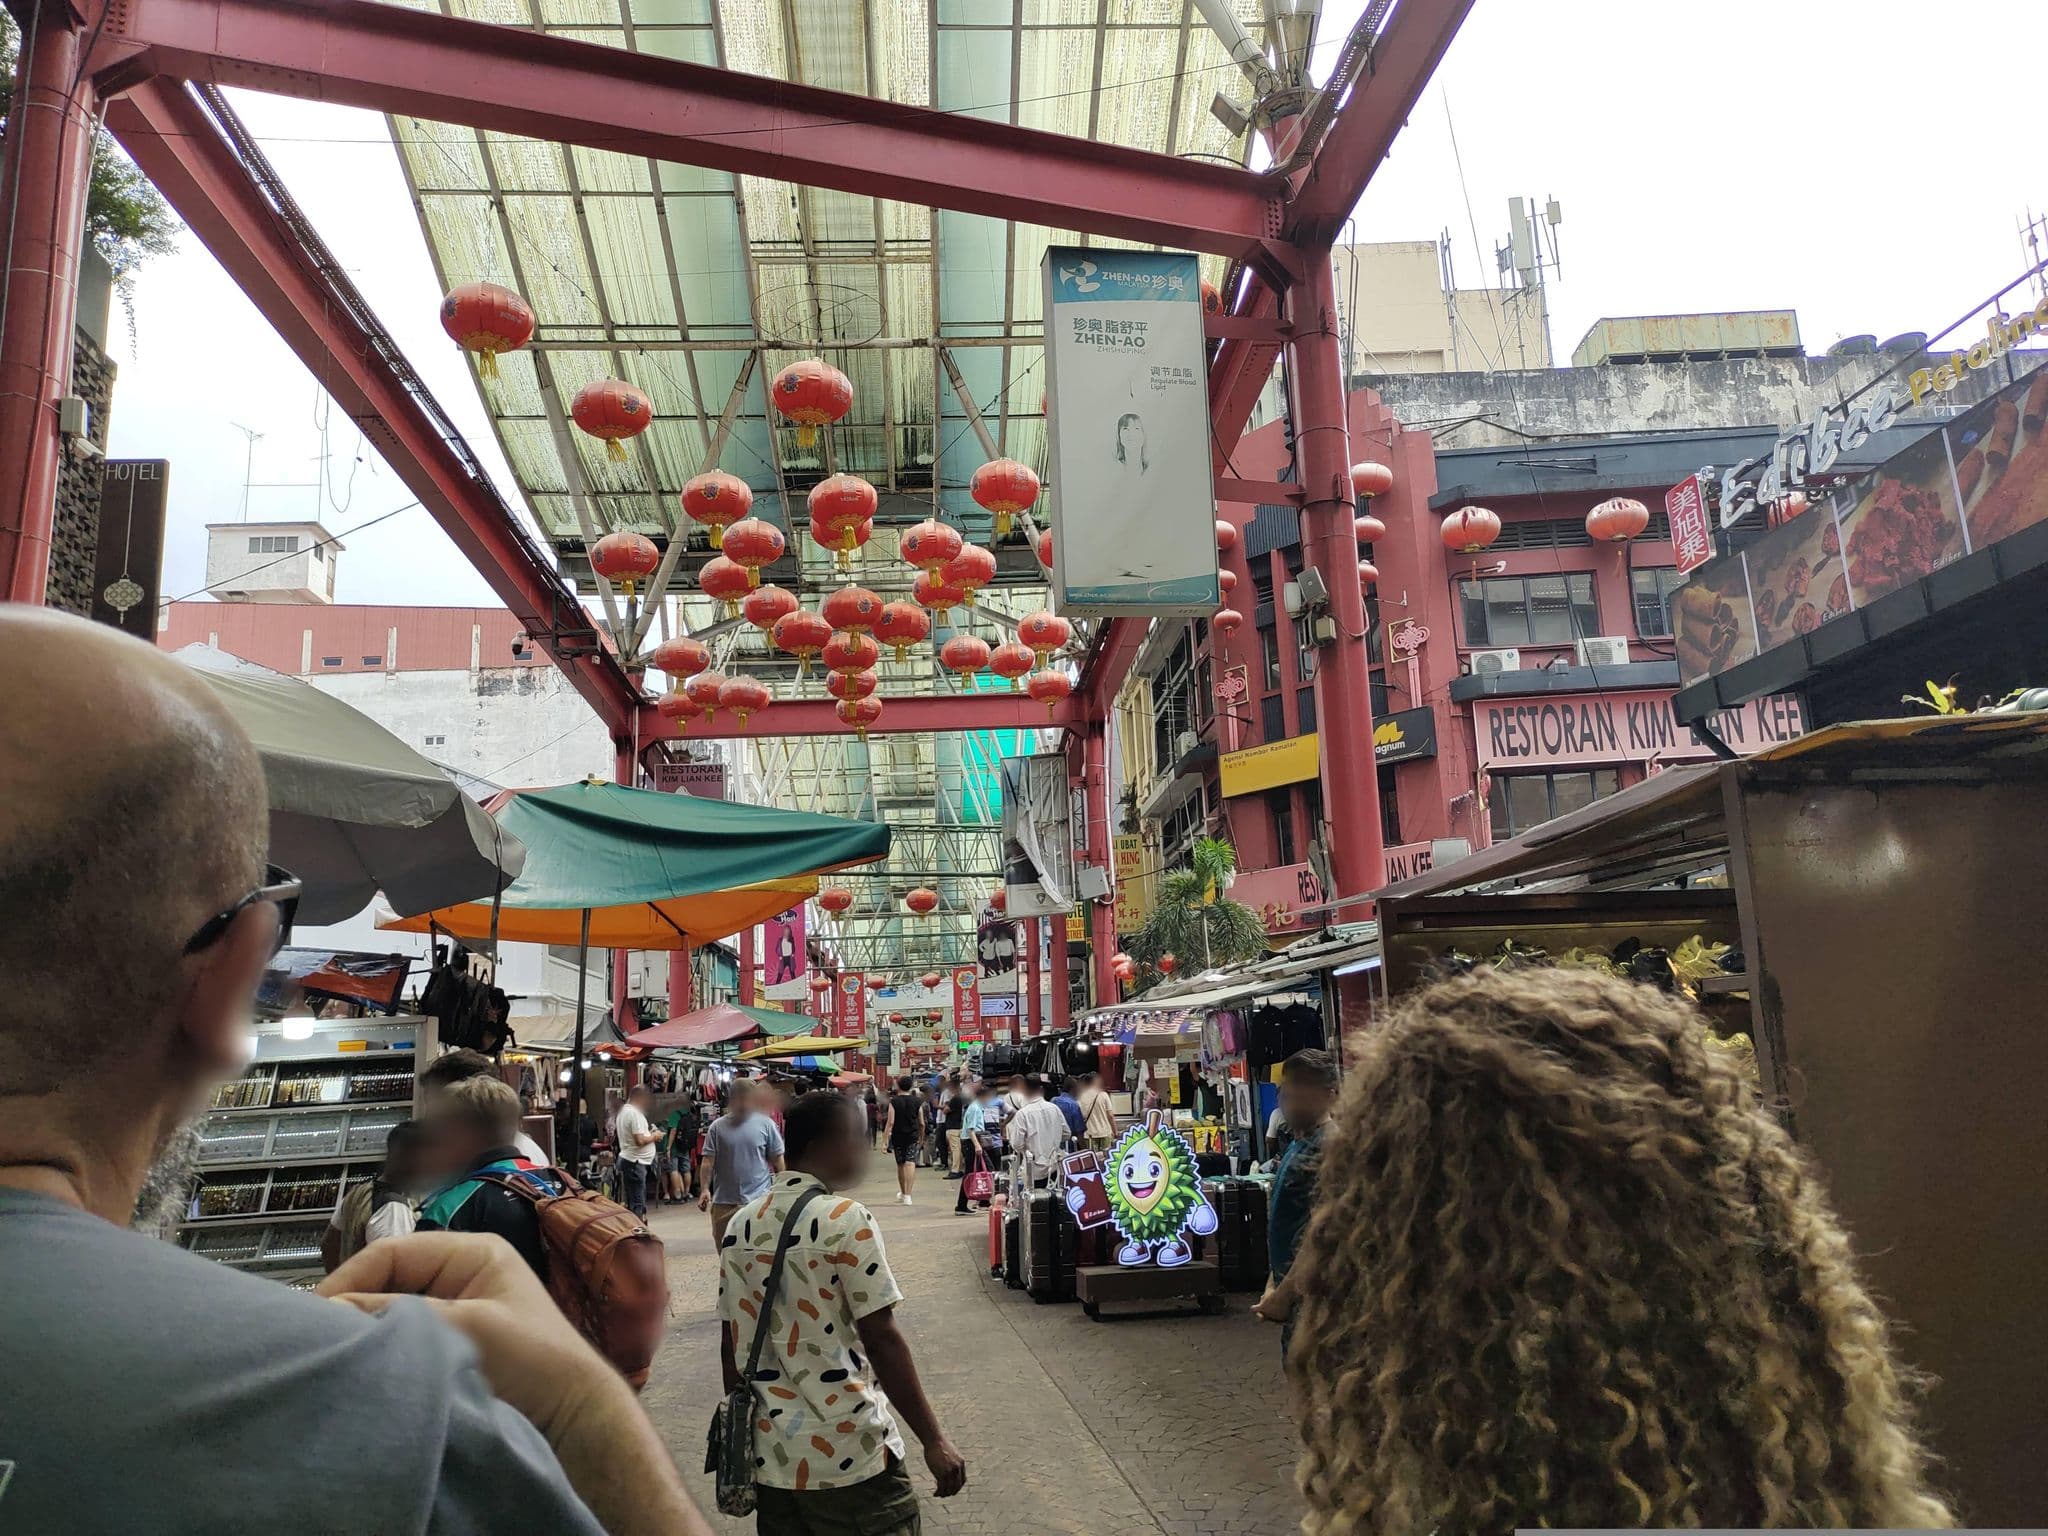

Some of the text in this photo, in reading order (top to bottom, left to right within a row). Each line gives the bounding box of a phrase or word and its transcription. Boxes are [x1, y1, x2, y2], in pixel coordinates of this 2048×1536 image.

[1102, 271, 1151, 283] ZHEN-AO
[1074, 332, 1146, 348] ZHEN-AO
[1150, 377, 1177, 386] Regulate
[1719, 385, 1897, 528] Edibee
[105, 463, 161, 480] HOTEL
[1489, 702, 1616, 758] RESTORAN
[1626, 700, 1676, 750] KIM
[1754, 694, 1801, 743] KEE
[1375, 741, 1406, 755] agnum
[662, 765, 723, 775] RESTORAN
[662, 774, 724, 783] KIM LIAN KEE
[1120, 839, 1137, 849] UBAT
[1117, 866, 1134, 875] prise
[1385, 855, 1408, 885] IAN
